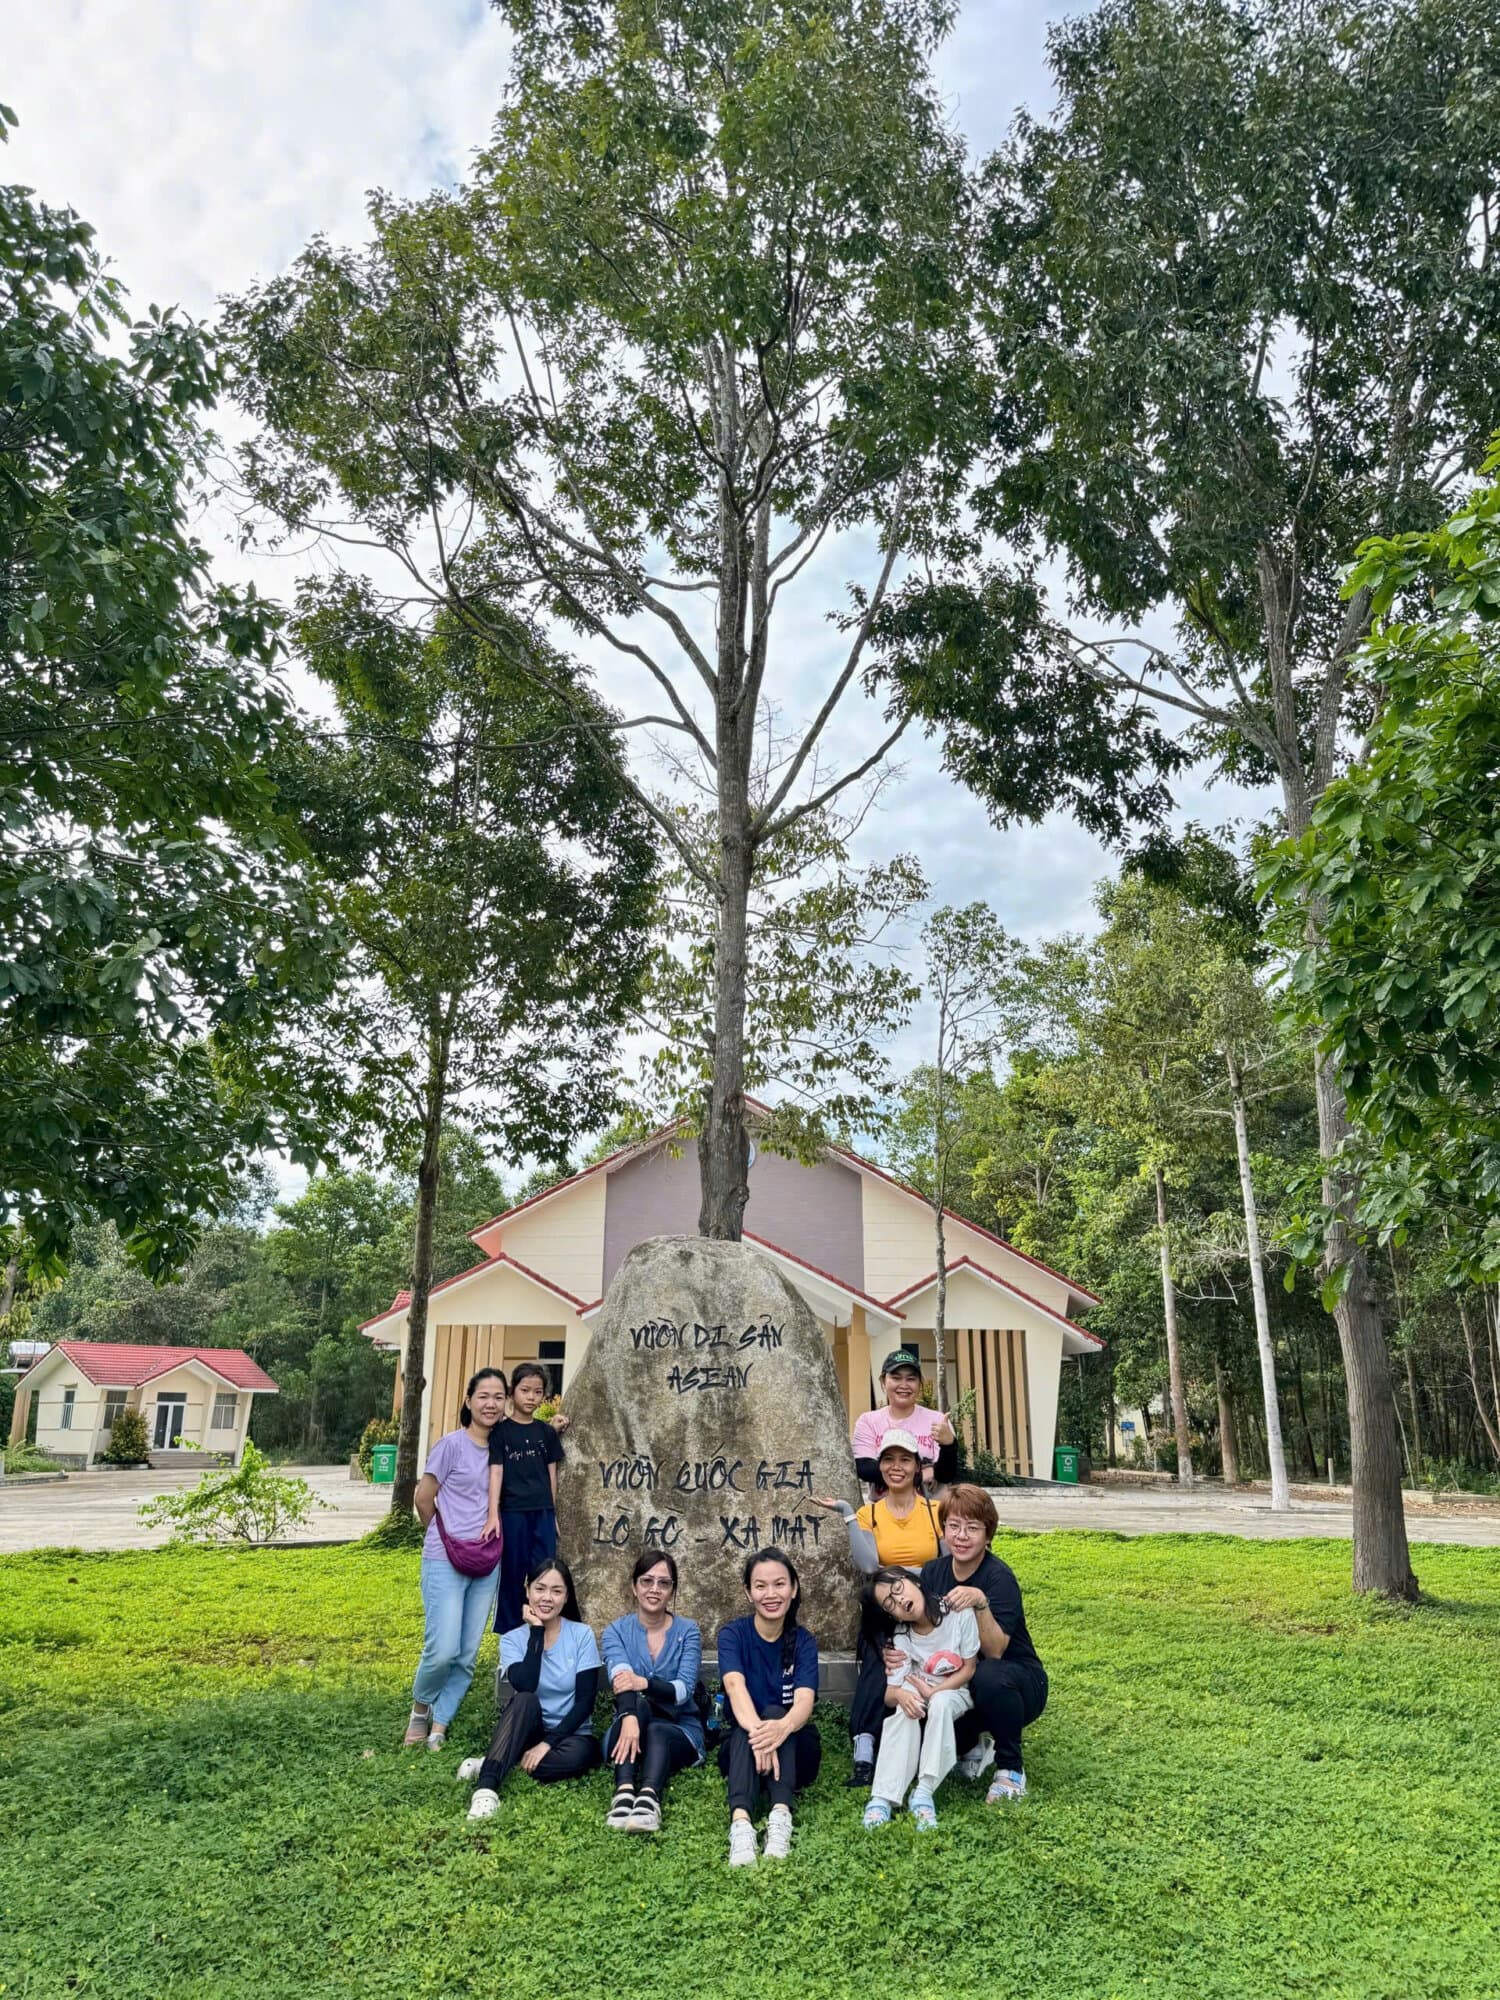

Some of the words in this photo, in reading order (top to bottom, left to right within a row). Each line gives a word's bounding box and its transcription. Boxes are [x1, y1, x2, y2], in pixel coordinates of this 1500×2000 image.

[630, 1317, 689, 1350] VƯỜN
[694, 1323, 731, 1349] DI
[736, 1314, 786, 1351] SẢN
[667, 1362, 753, 1394] ASEAN
[599, 1453, 666, 1490] VƯỜN
[673, 1442, 746, 1493] QUỐC
[756, 1460, 815, 1496] GIA
[593, 1504, 634, 1545] LÒ
[643, 1506, 684, 1546] GÒ
[719, 1515, 761, 1551] XA
[772, 1496, 828, 1550] MÁT
